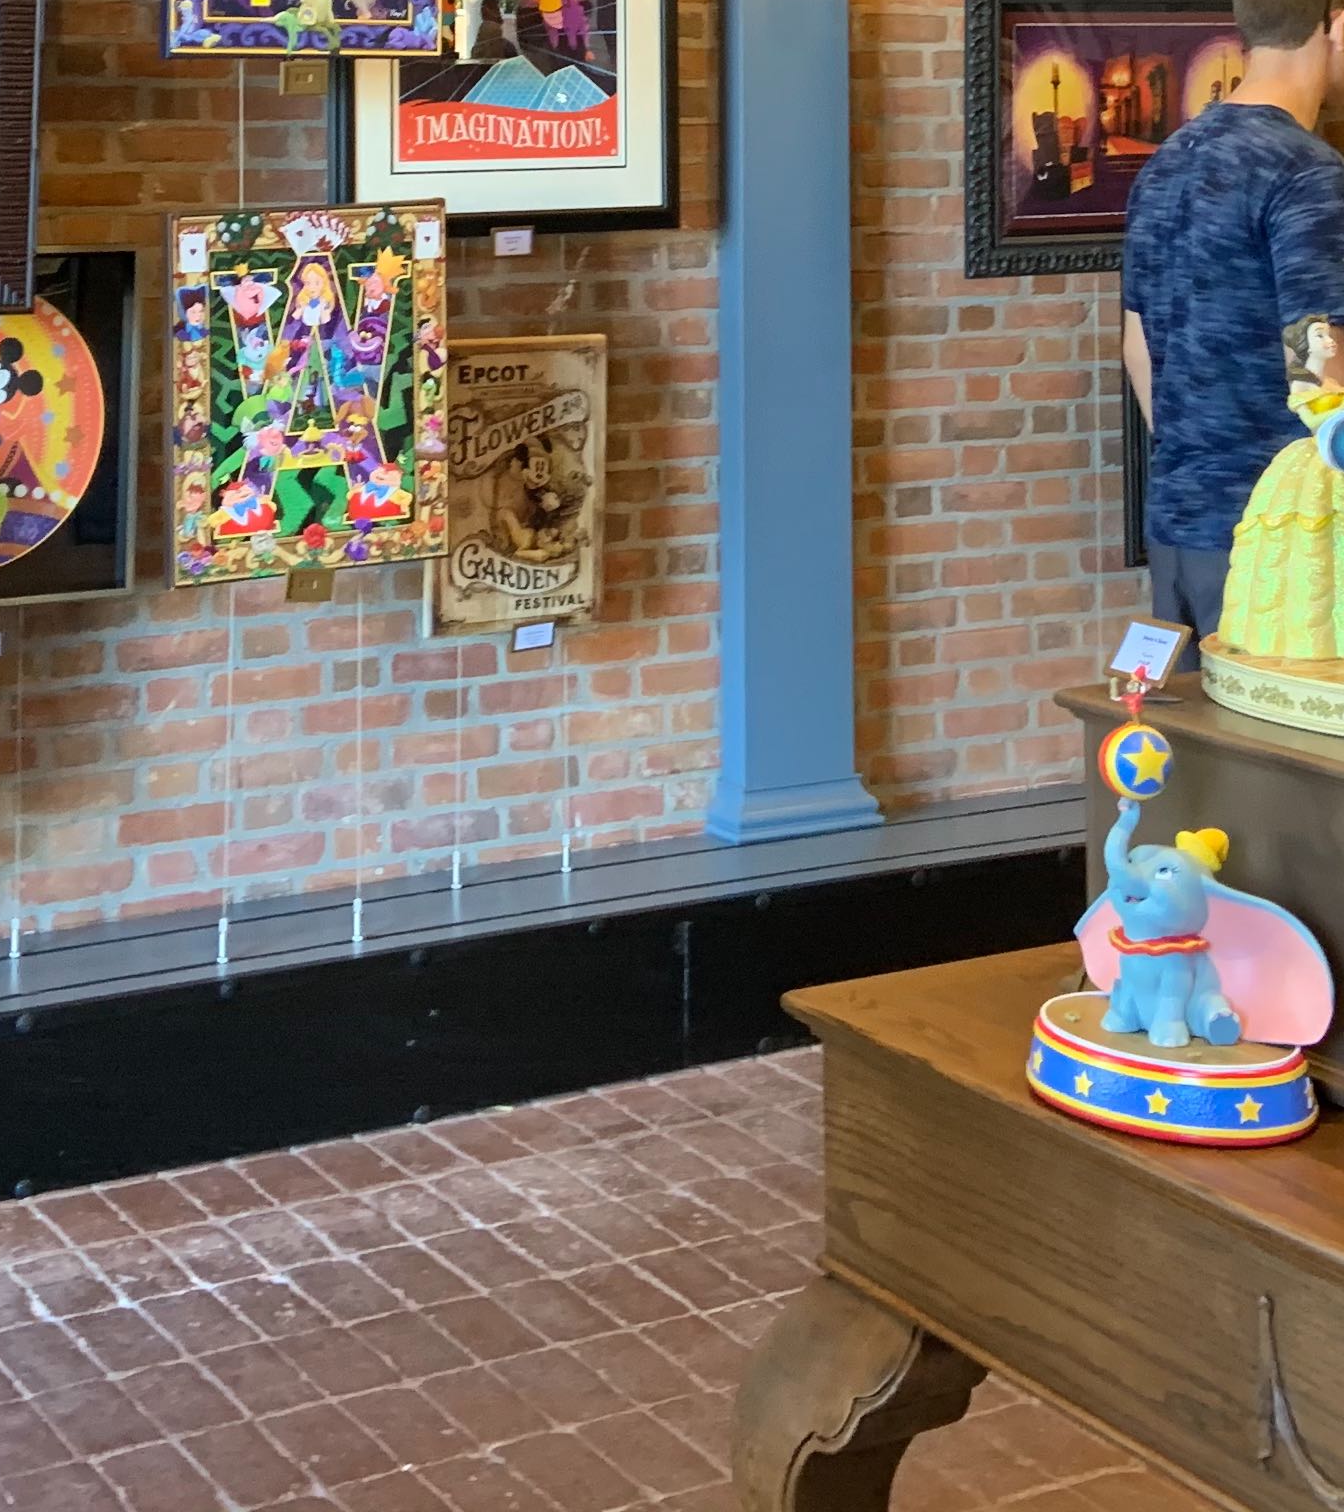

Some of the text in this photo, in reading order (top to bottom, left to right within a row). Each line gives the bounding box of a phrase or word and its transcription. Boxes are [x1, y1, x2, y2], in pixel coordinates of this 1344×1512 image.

[414, 114, 605, 150] IMAGINATION!
[458, 364, 530, 385] EPCOT
[448, 404, 556, 466] FLOWER
[458, 543, 561, 590] GARDEN
[514, 593, 585, 611] FESTIVAL
